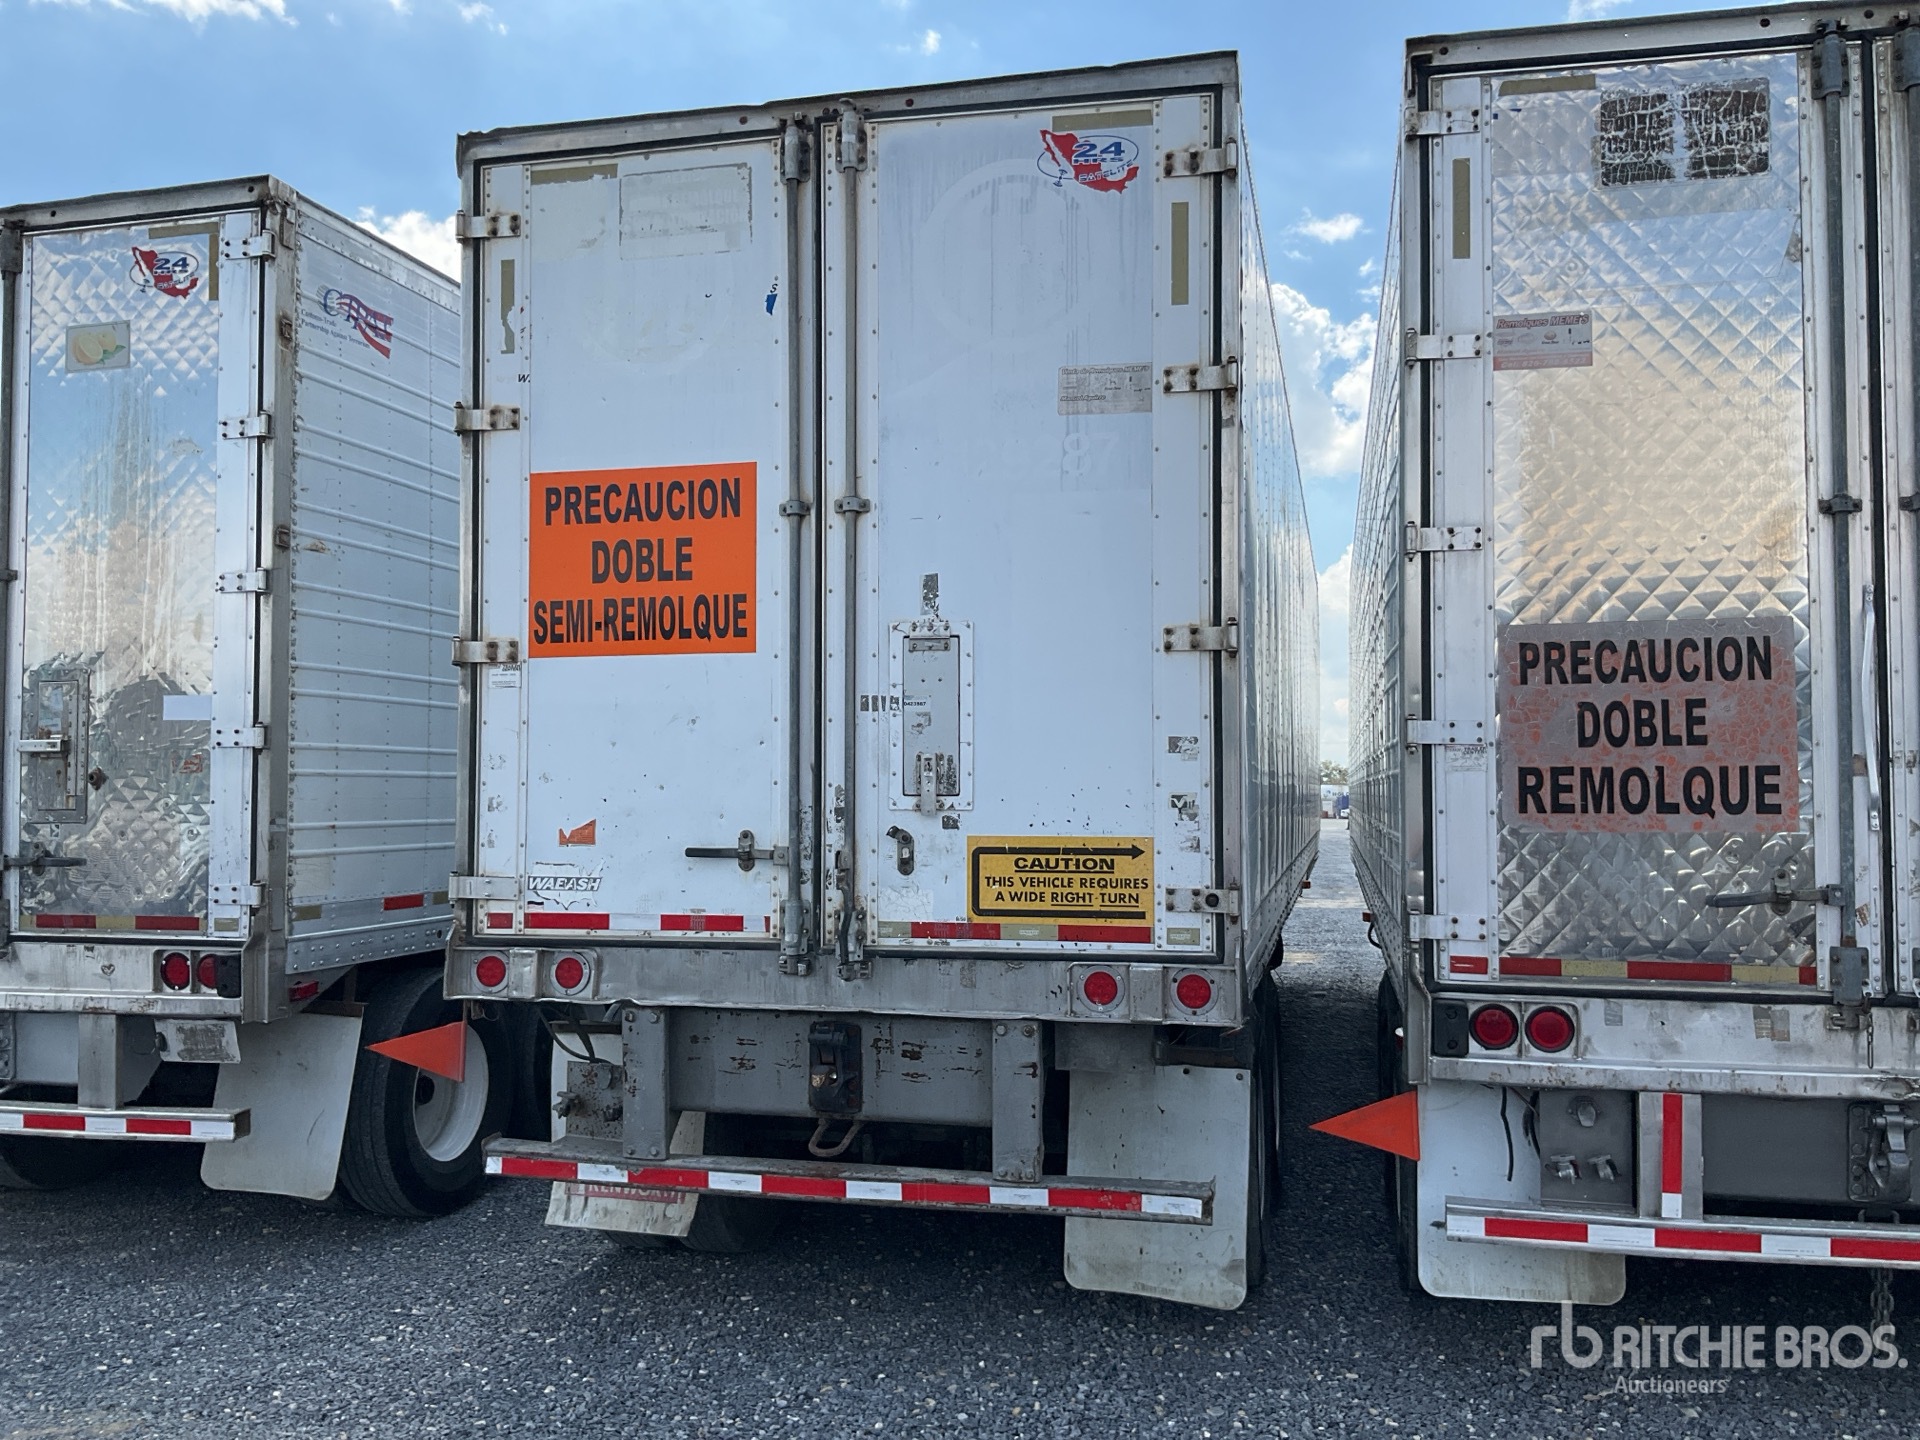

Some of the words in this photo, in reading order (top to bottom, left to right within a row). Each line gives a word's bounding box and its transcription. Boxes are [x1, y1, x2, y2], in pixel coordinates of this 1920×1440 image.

[1073, 142, 1125, 159] 24
[1079, 160, 1134, 182] SATELITE
[153, 257, 189, 270] 24
[1496, 318, 1549, 330] Remolques
[545, 477, 741, 526] PRECAUCION
[591, 537, 693, 584] DOBLE
[533, 593, 748, 645] SEMI-REMOLQUE
[1519, 636, 1772, 686] PRECAUCION
[1577, 698, 1708, 748] DOBLE
[1518, 765, 1782, 819] REMOLQUE
[1014, 857, 1115, 871] CAUTION
[985, 876, 1015, 888] THIS
[1019, 876, 1074, 888] VEHICLE
[1080, 877, 1149, 889] REQUIRES
[995, 891, 1005, 902] A
[1009, 891, 1046, 902] WIDE
[1051, 892, 1094, 903] RIGHT
[1099, 892, 1140, 904] TURN
